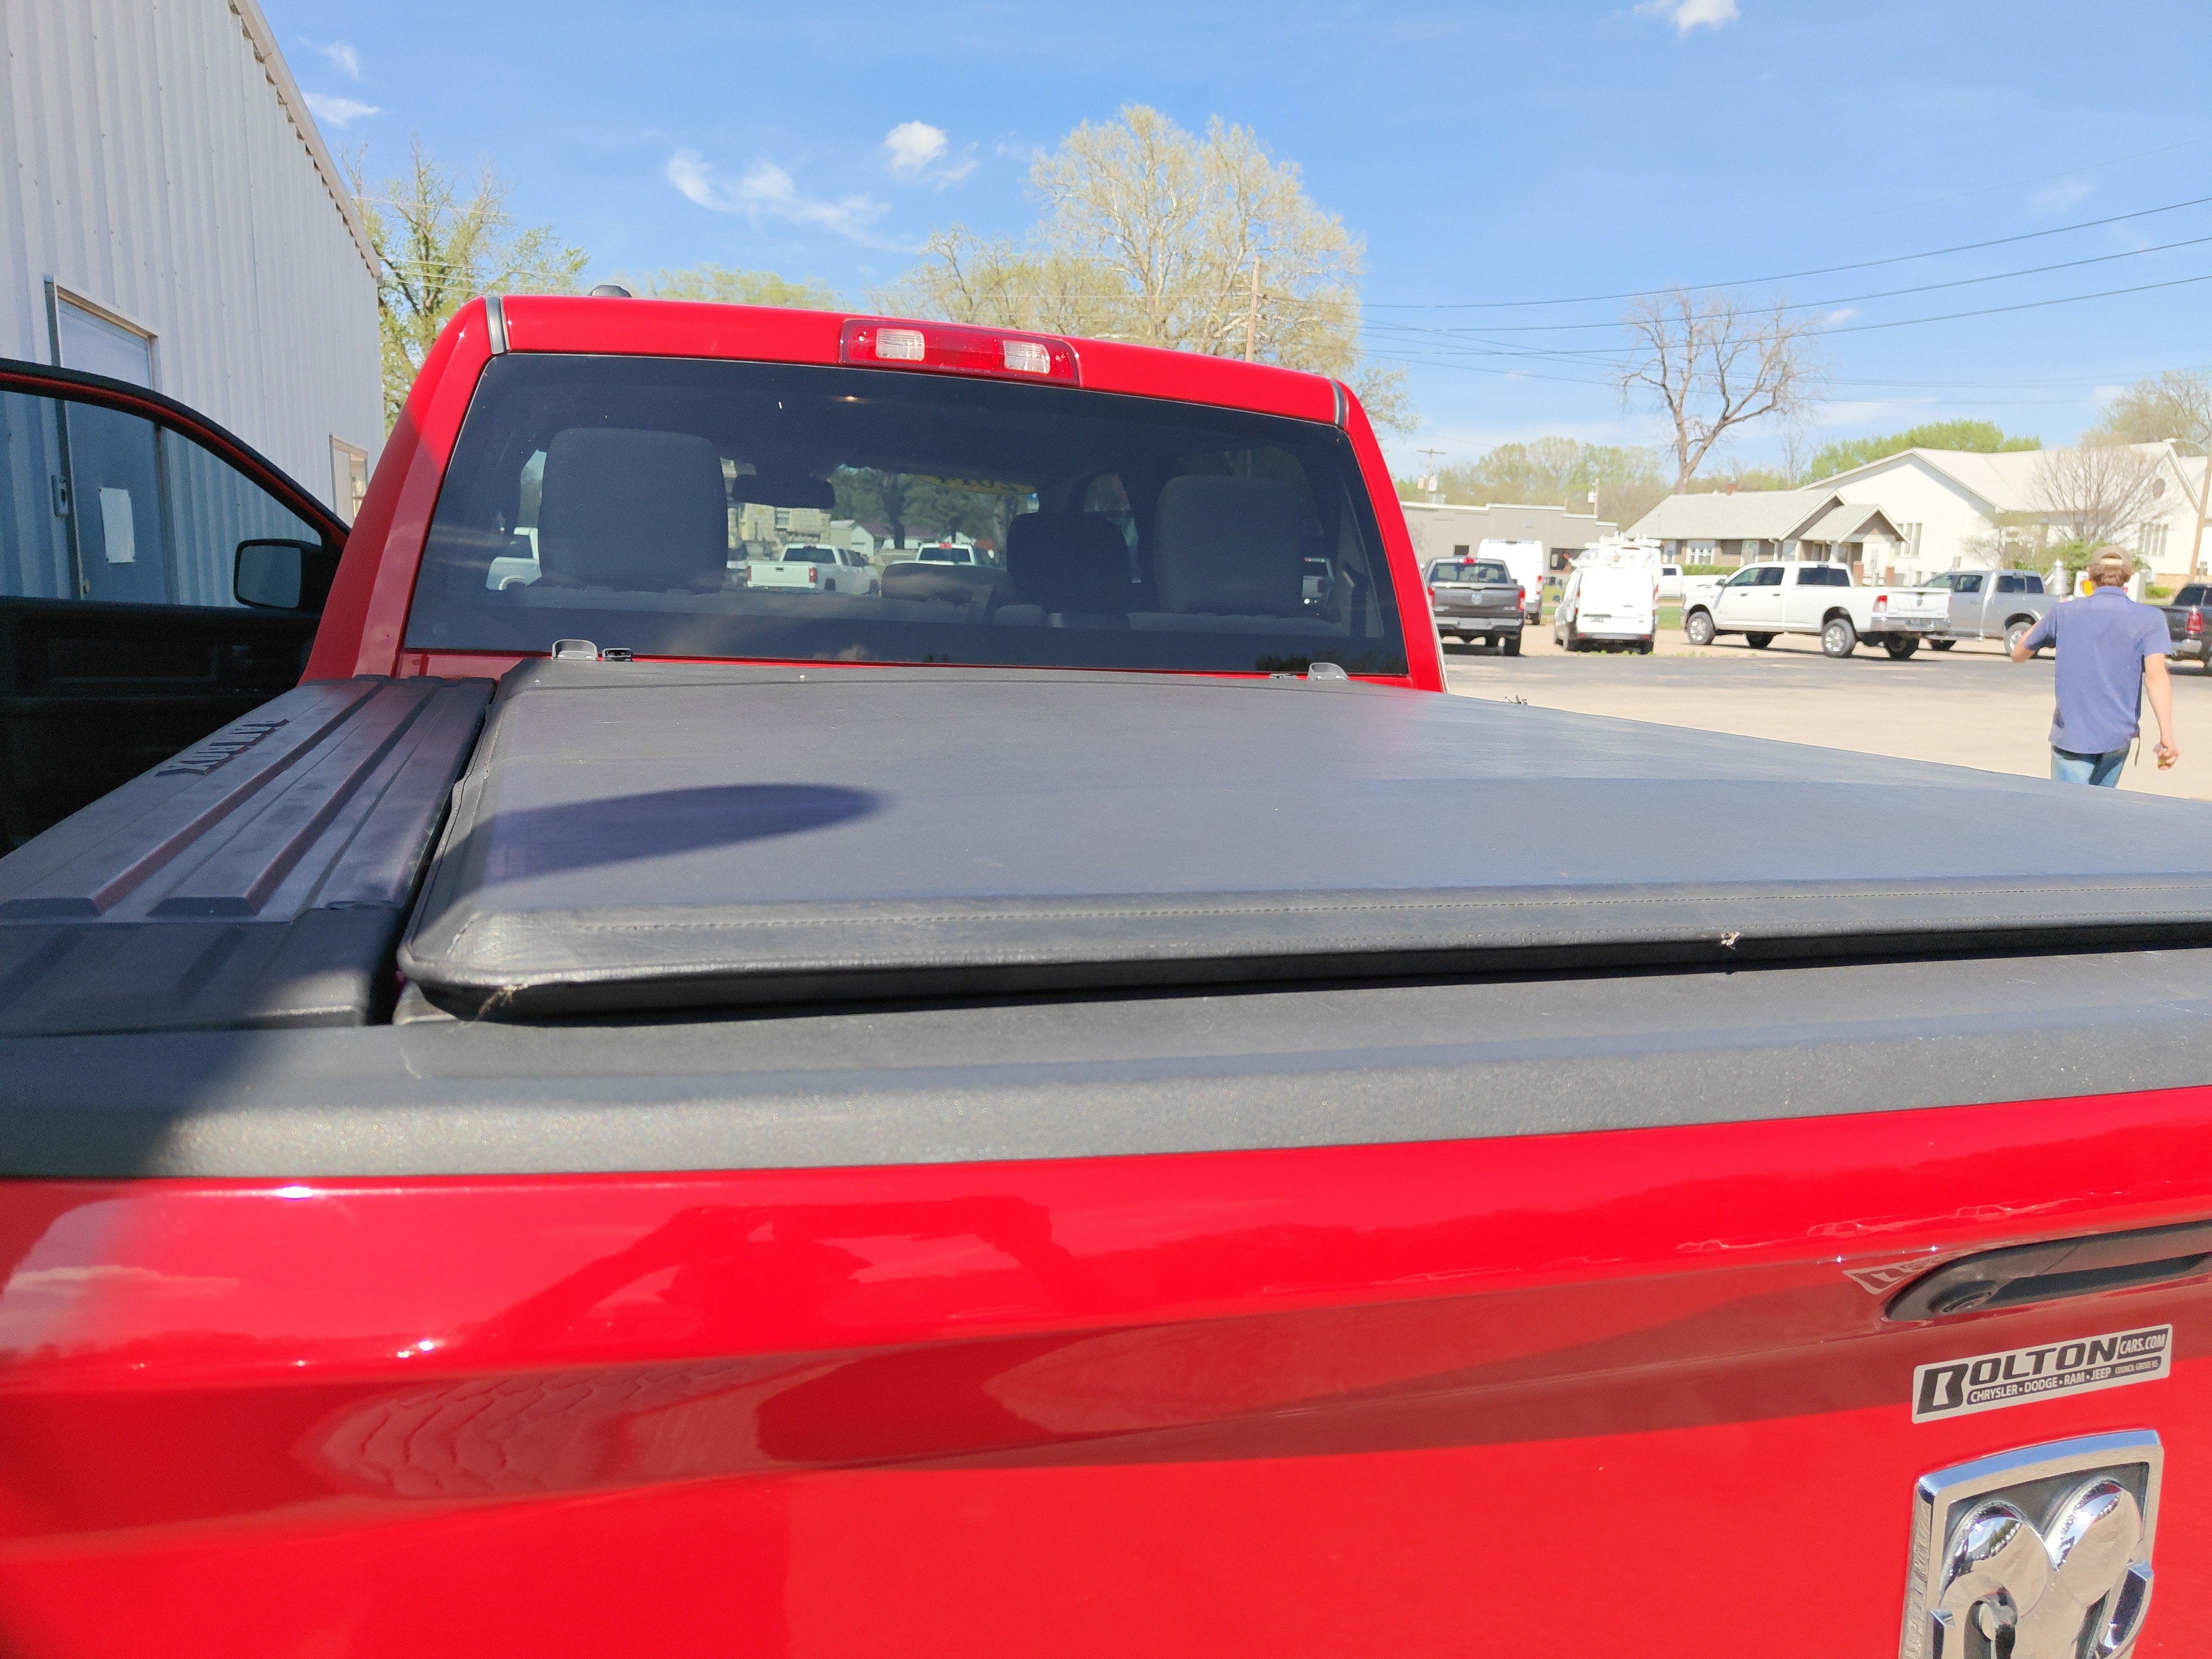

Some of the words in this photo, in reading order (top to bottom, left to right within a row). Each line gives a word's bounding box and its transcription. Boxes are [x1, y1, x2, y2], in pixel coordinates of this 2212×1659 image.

[154, 719, 290, 777] RAMBOX
[1917, 1337, 2118, 1415] BOLTON
[2120, 1333, 2166, 1354] CARS.COM
[1971, 1384, 2018, 1402] CHRYSLER
[2024, 1377, 2058, 1393] DODGE
[2064, 1372, 2085, 1385] RAM
[2090, 1366, 2111, 1380] JEEP
